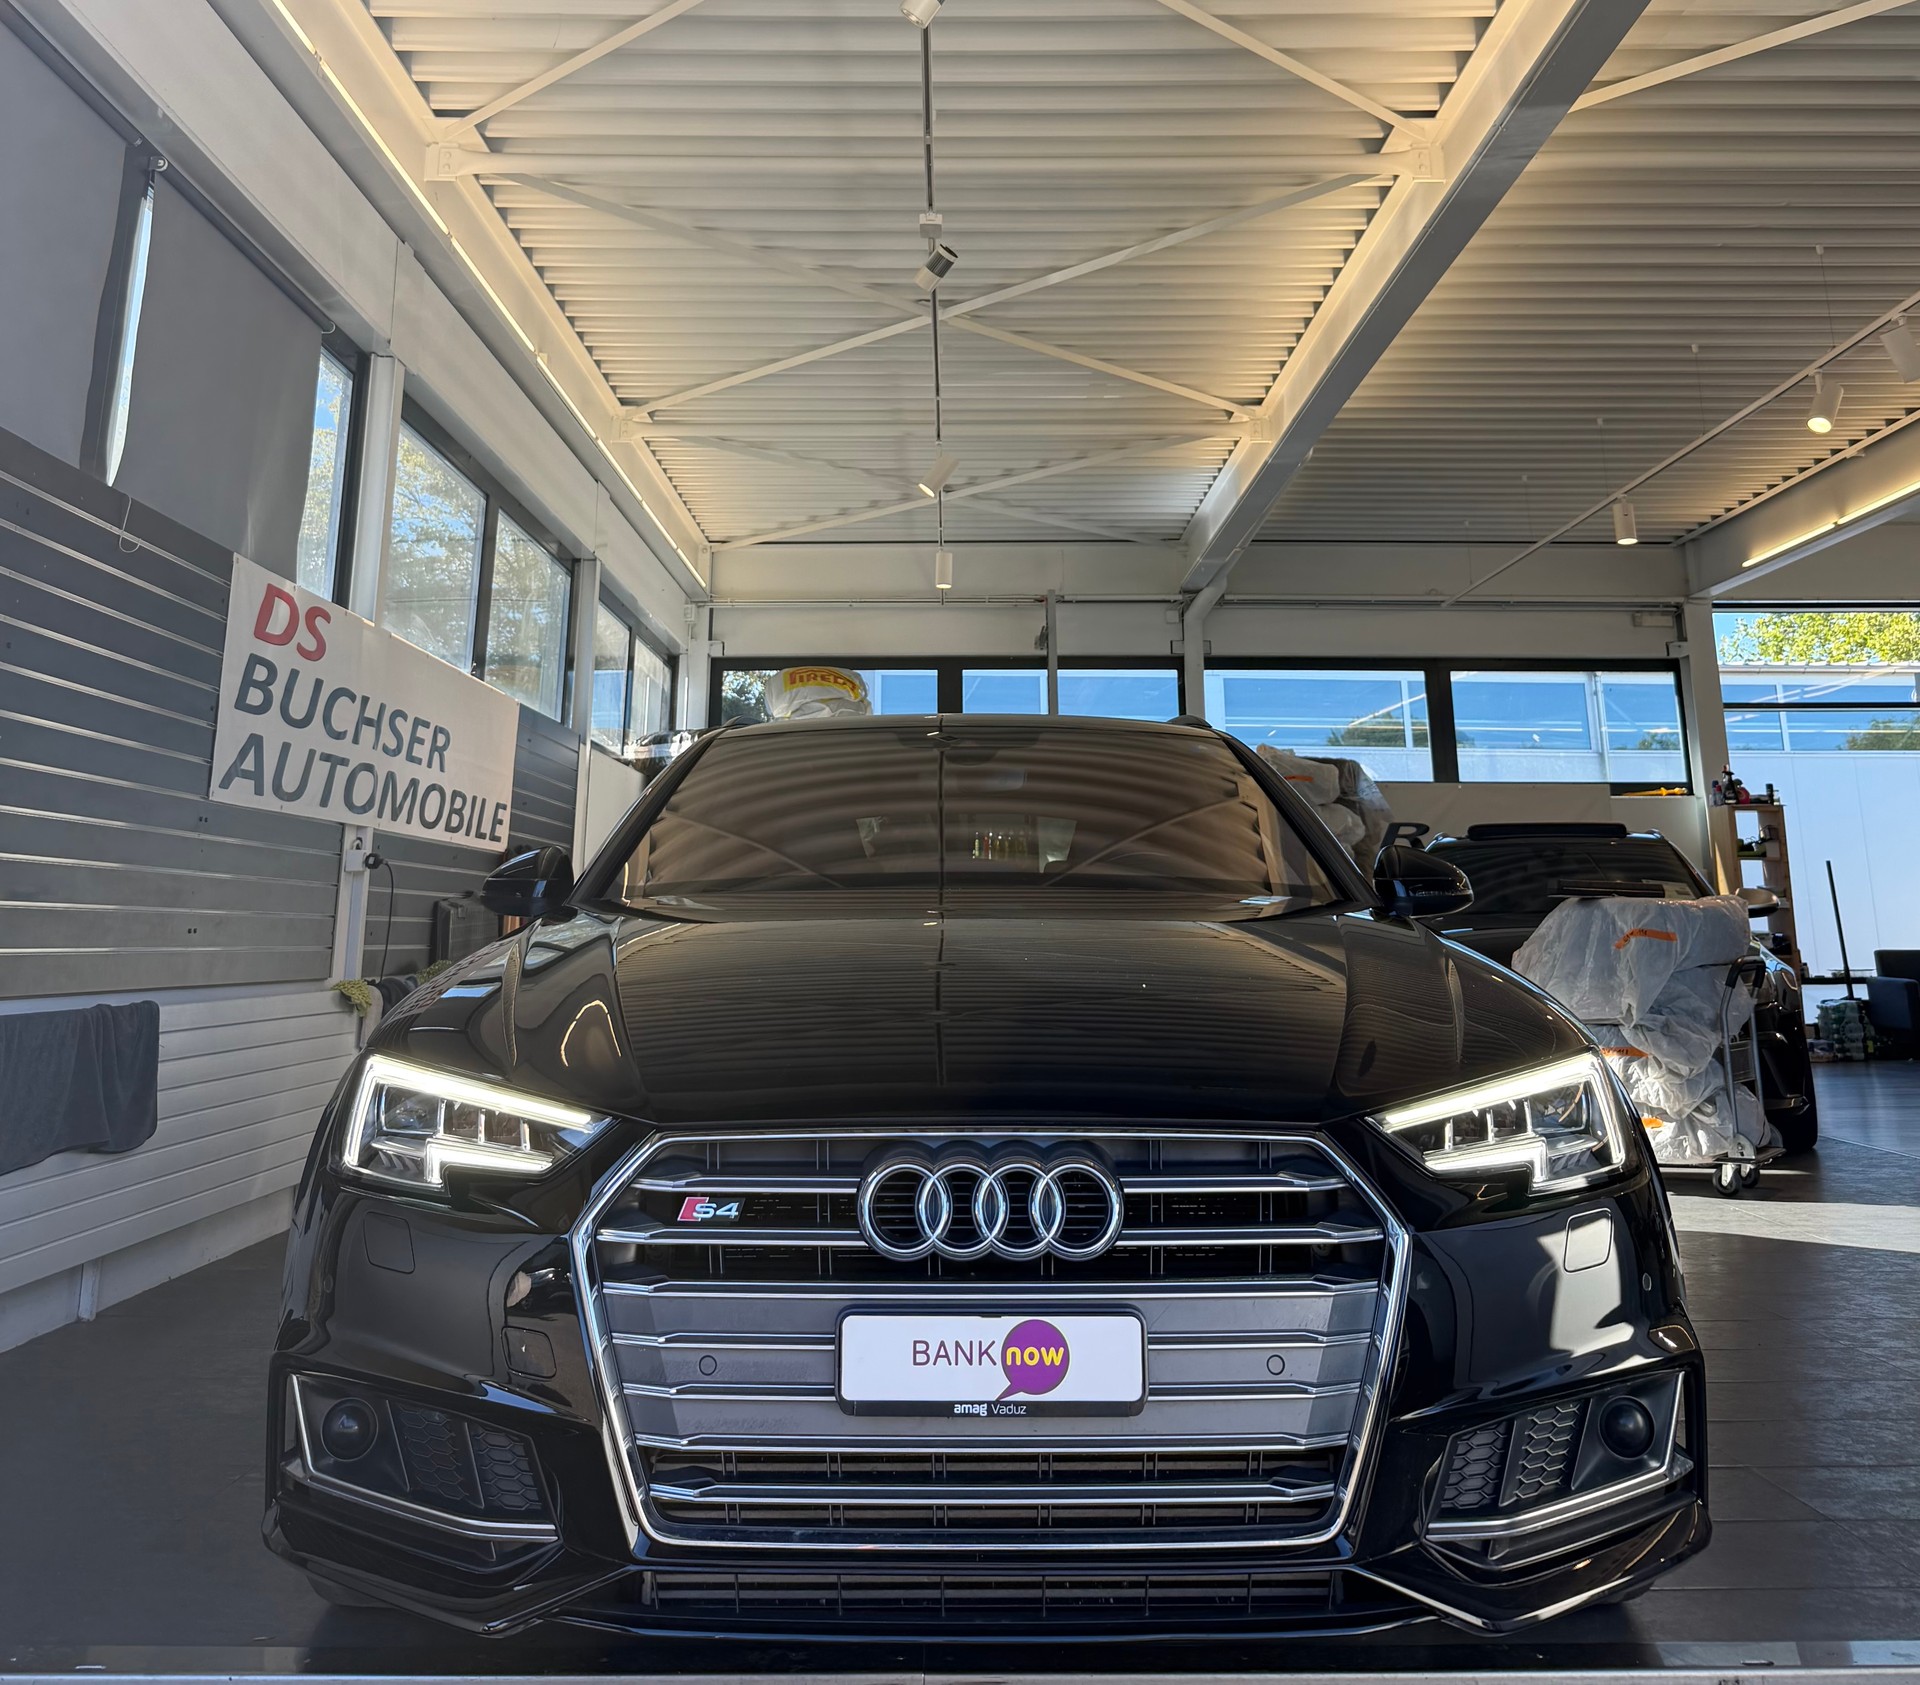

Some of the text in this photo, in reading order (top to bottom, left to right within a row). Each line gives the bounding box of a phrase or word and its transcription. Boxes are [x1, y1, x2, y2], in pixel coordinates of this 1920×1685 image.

[253, 582, 332, 662] DS
[789, 668, 857, 691] PIREL
[233, 653, 452, 773] BUCHSER
[218, 733, 508, 843] AUTOMOBILE
[692, 1202, 740, 1219] S4
[912, 1339, 1065, 1367] BANK now
[953, 1403, 1027, 1416] amag Vaduz
